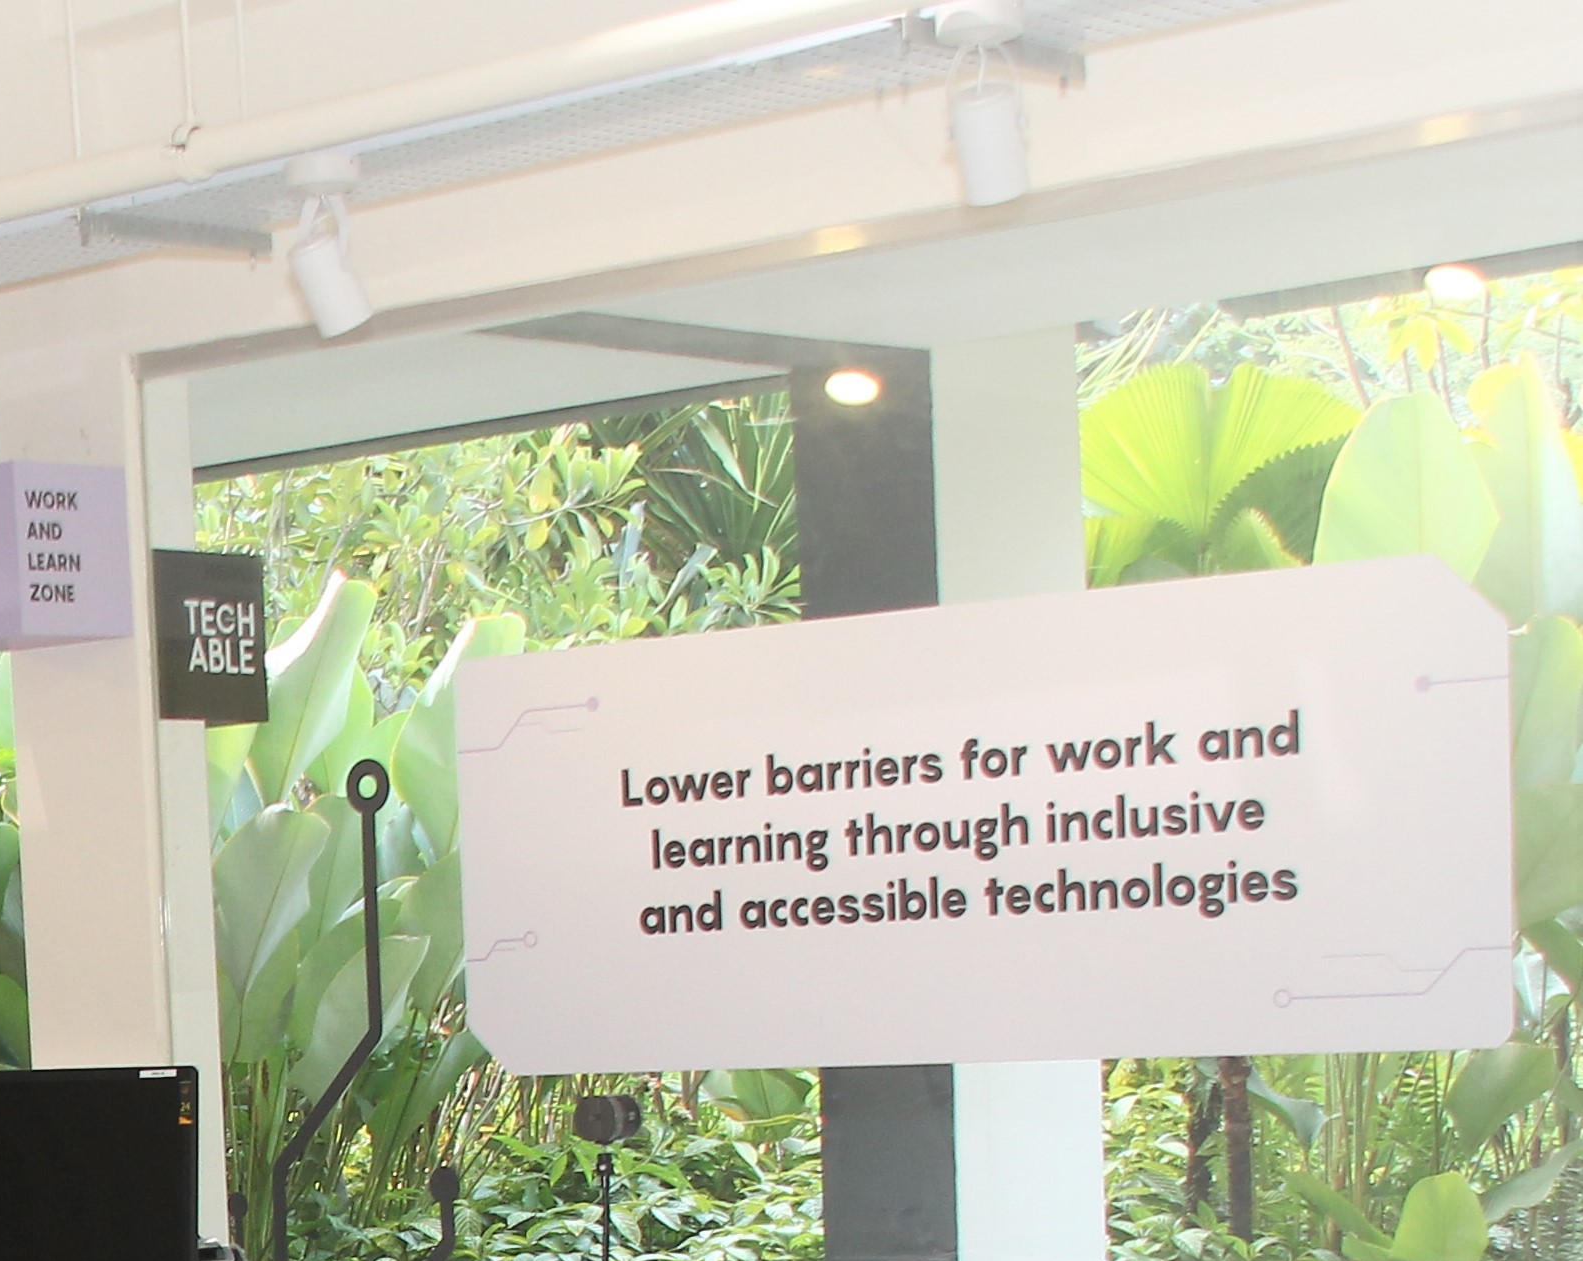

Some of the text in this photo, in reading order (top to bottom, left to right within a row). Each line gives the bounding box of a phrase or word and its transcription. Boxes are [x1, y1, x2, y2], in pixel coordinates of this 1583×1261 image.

[25, 492, 78, 510] WORK
[27, 522, 62, 540] AND
[29, 554, 81, 572] LEARN
[30, 584, 75, 602] ZONE
[184, 600, 255, 637] TECH
[189, 639, 255, 675] ABLE
[621, 710, 1300, 807] Lower barriers for work and
[650, 792, 1266, 872] learning through inclusive
[640, 860, 1298, 934] and accessible technologies
